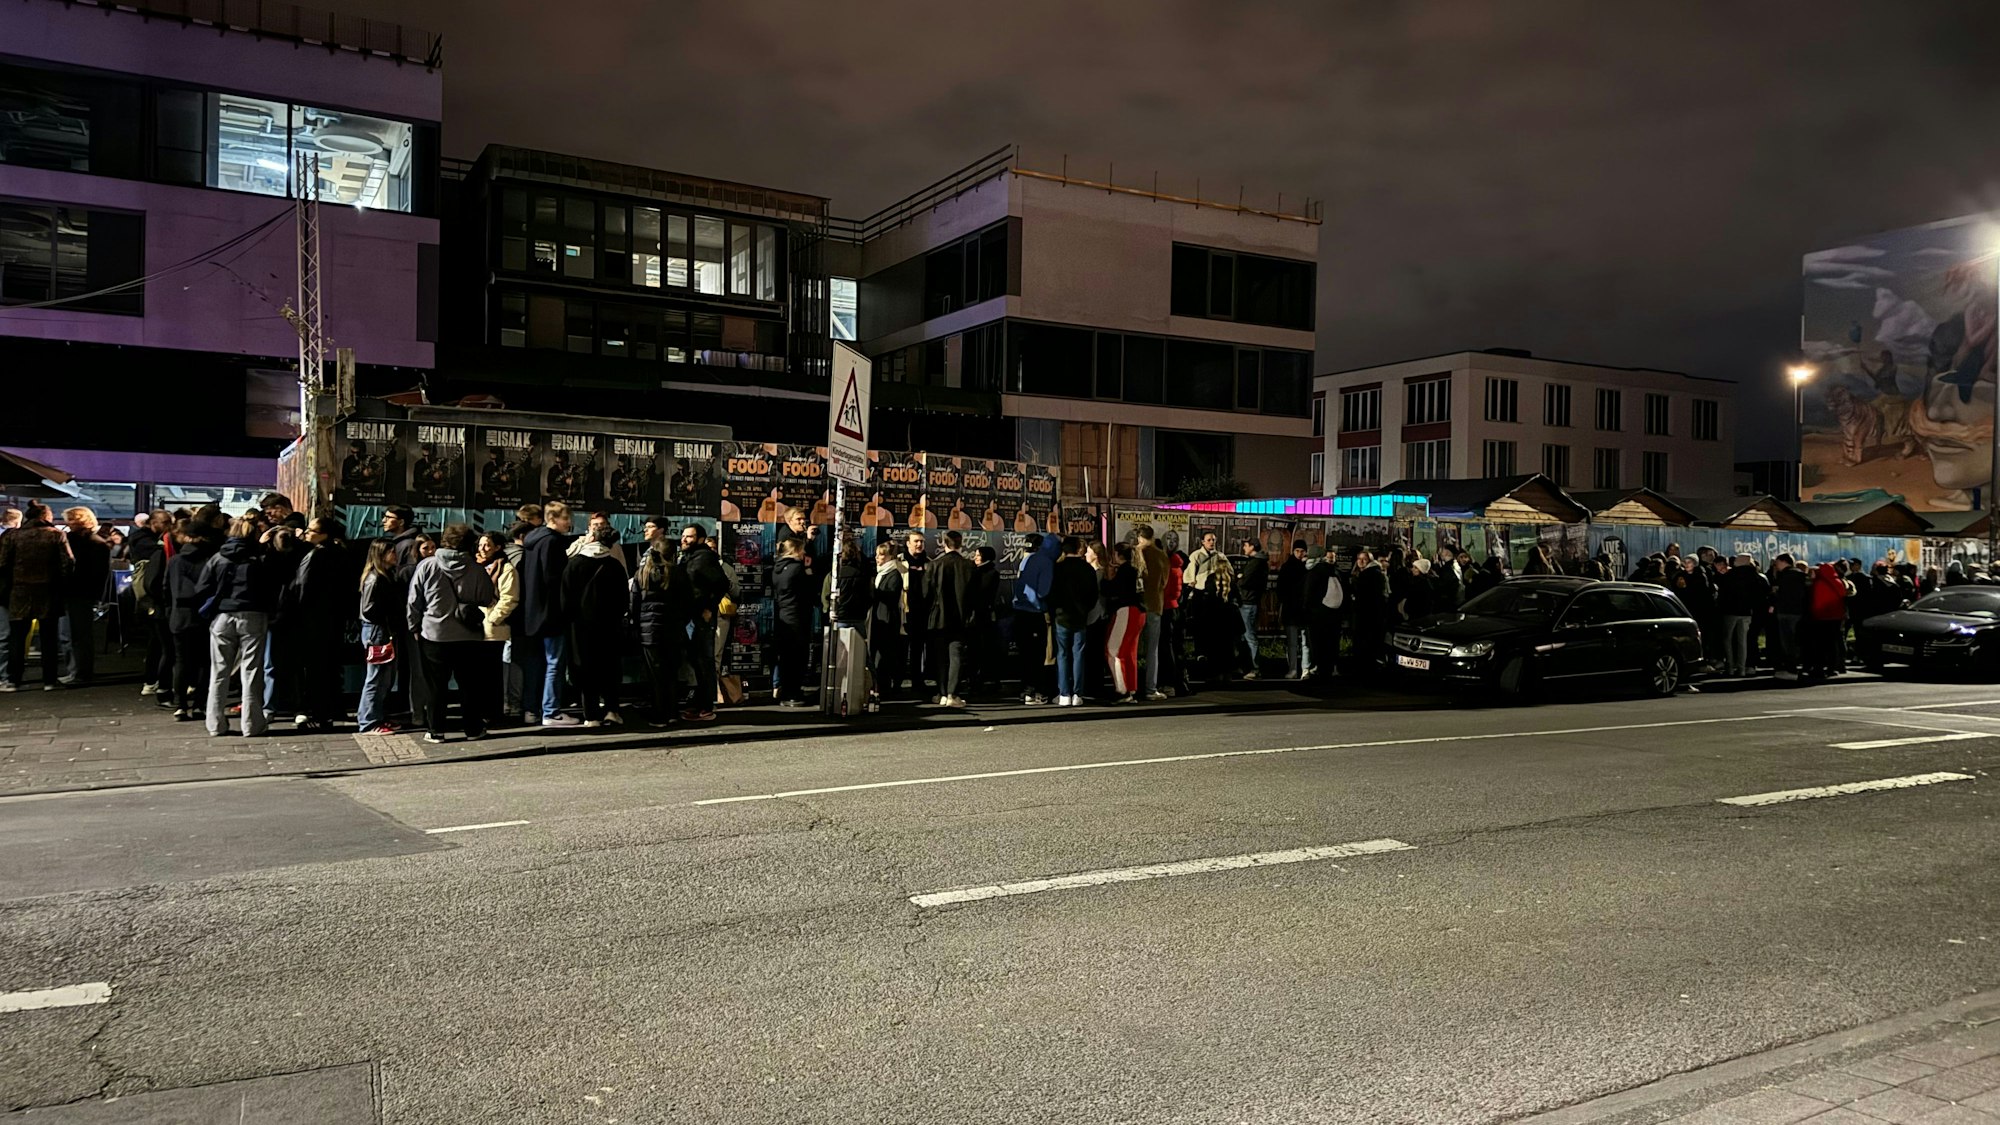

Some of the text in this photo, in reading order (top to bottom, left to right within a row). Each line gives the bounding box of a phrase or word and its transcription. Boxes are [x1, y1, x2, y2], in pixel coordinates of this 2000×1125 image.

[359, 422, 396, 440] ISAAK
[430, 426, 465, 444] ISAAK
[497, 430, 532, 448] ISAAK
[563, 434, 595, 451] ISAAK
[625, 439, 656, 456] ISAAK
[683, 443, 713, 459] ISAAK
[1600, 538, 1620, 554] LIVE
